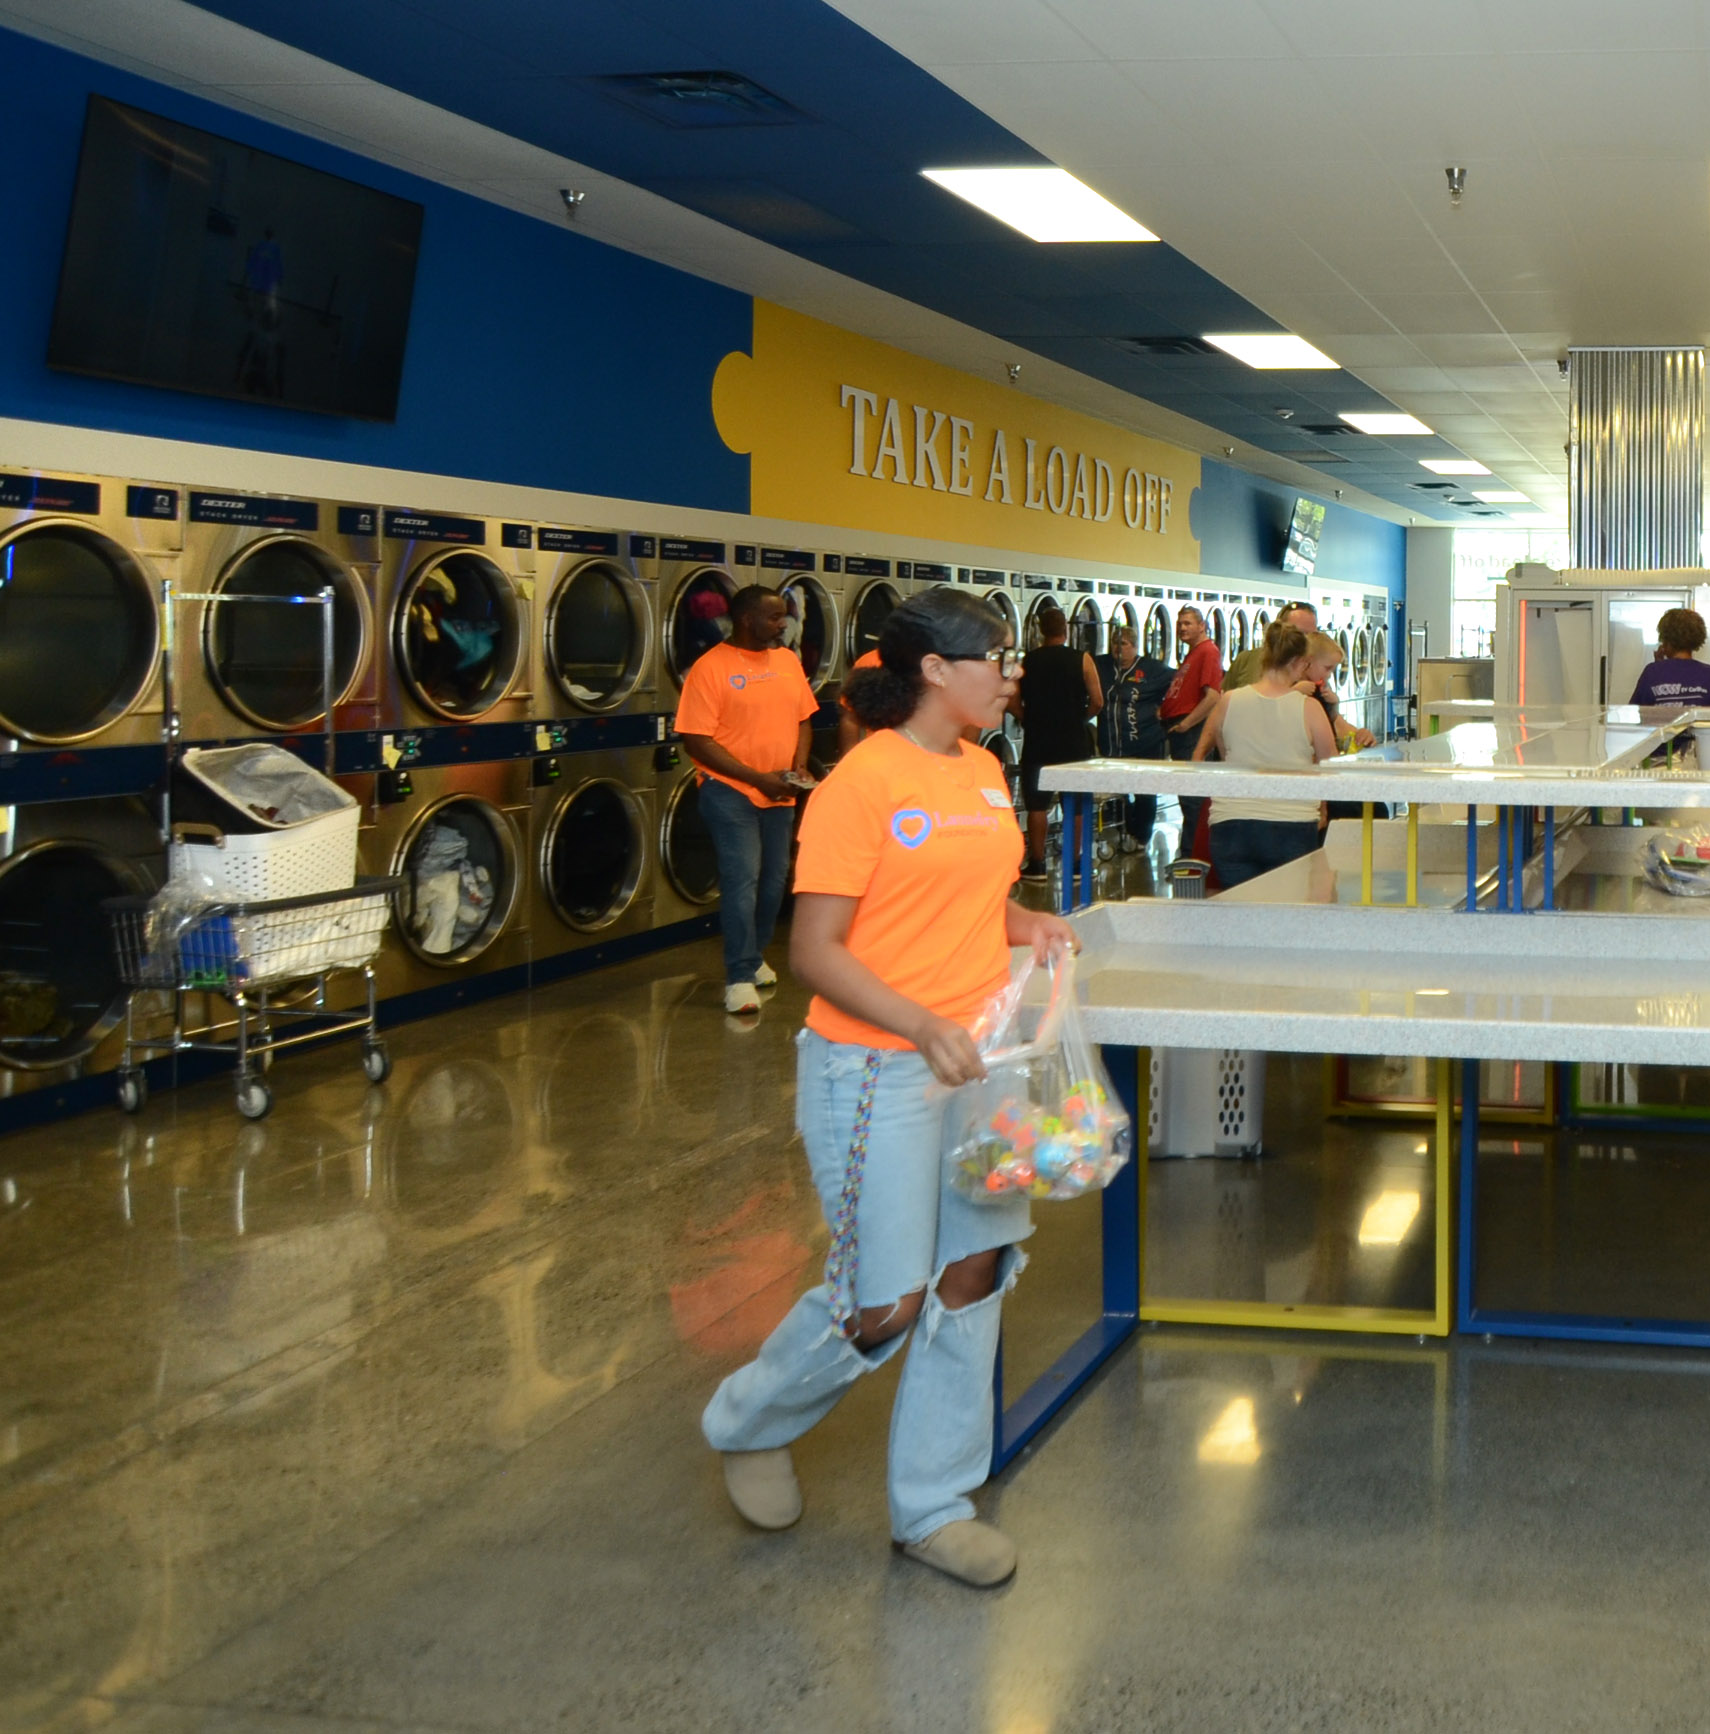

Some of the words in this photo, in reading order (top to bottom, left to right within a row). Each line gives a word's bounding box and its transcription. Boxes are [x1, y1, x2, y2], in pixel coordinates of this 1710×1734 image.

[839, 384, 975, 497] TAKE
[984, 429, 1014, 504] A
[1024, 438, 1115, 522] LOAD
[1124, 467, 1173, 535] OFF
[200, 499, 247, 509] DEXTER
[393, 517, 430, 526] DEXTER
[934, 811, 998, 832] Laundry
